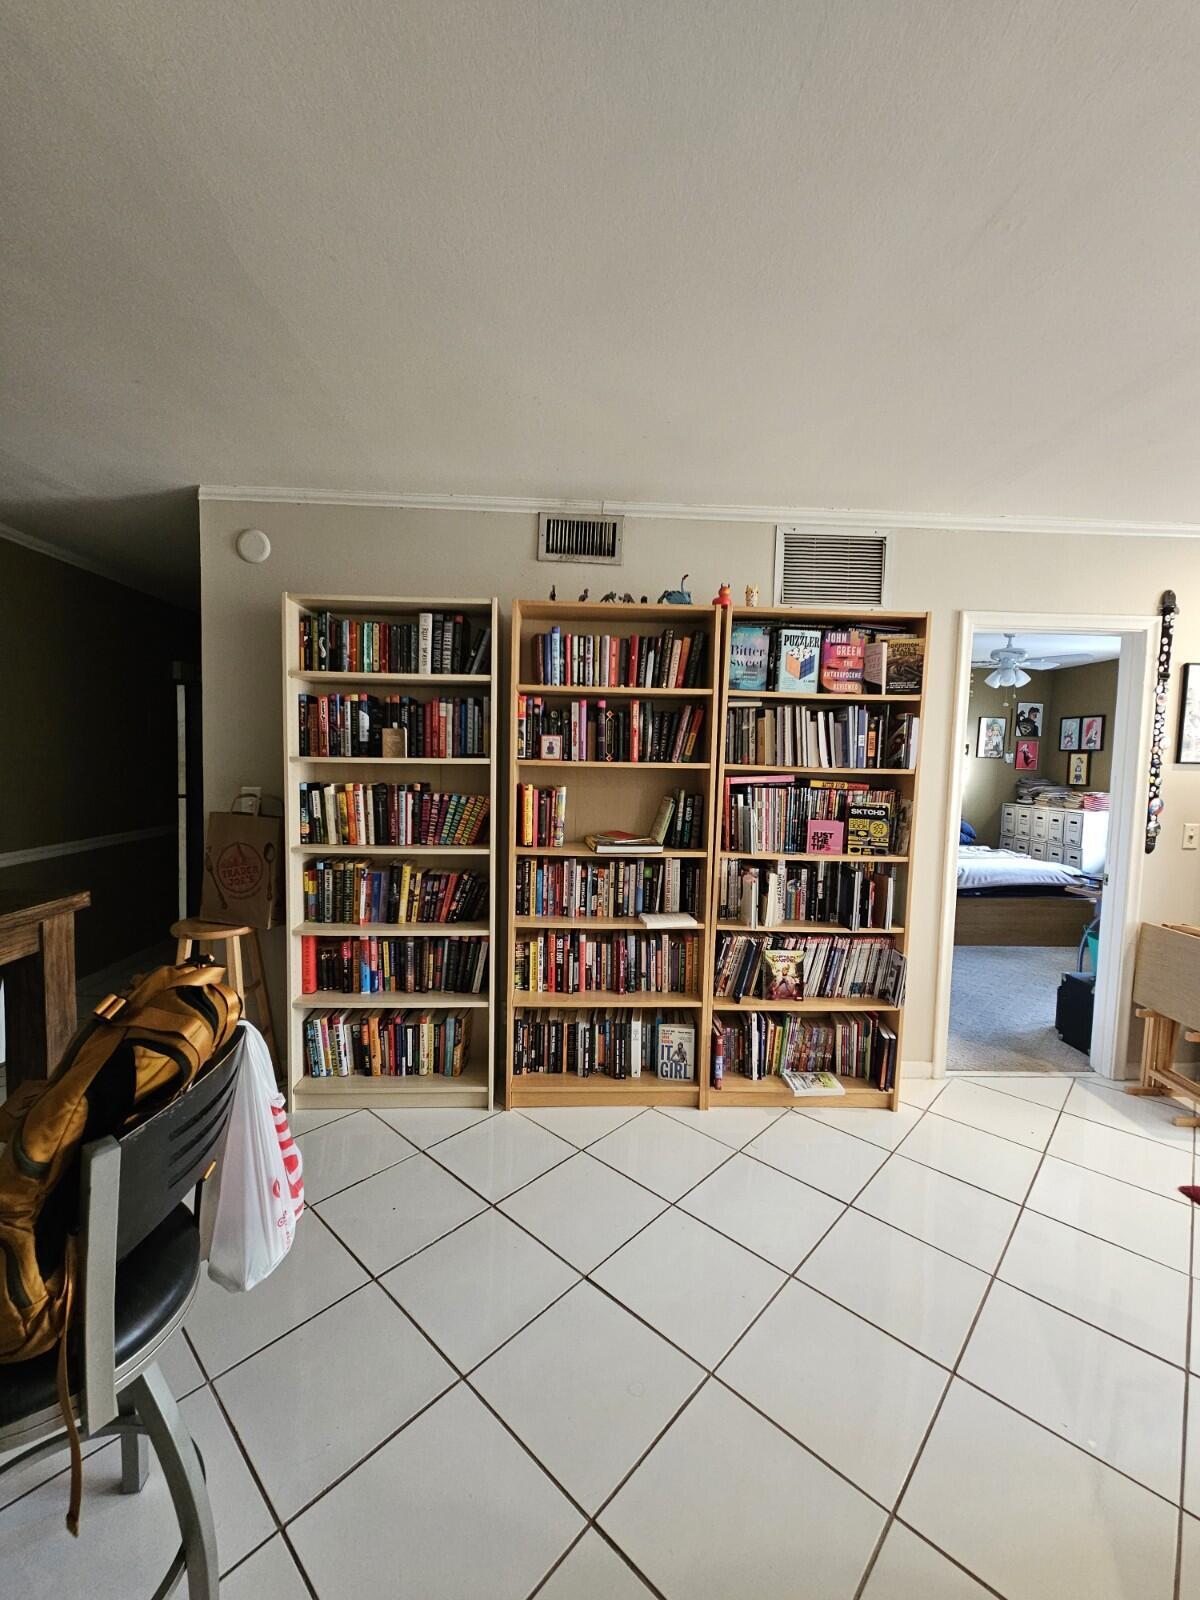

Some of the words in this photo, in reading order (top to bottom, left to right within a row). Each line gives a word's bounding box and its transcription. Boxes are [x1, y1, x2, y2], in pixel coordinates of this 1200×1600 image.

[443, 632, 452, 650] HELL
[784, 634, 820, 648] PUZZLER
[826, 632, 847, 643] JOHN
[730, 645, 765, 656] Bitter
[836, 646, 862, 656] GREEN
[442, 650, 450, 669] BENT
[222, 866, 259, 878] TRADER
[660, 1045, 673, 1060] IT
[660, 1062, 690, 1080] GIRL
